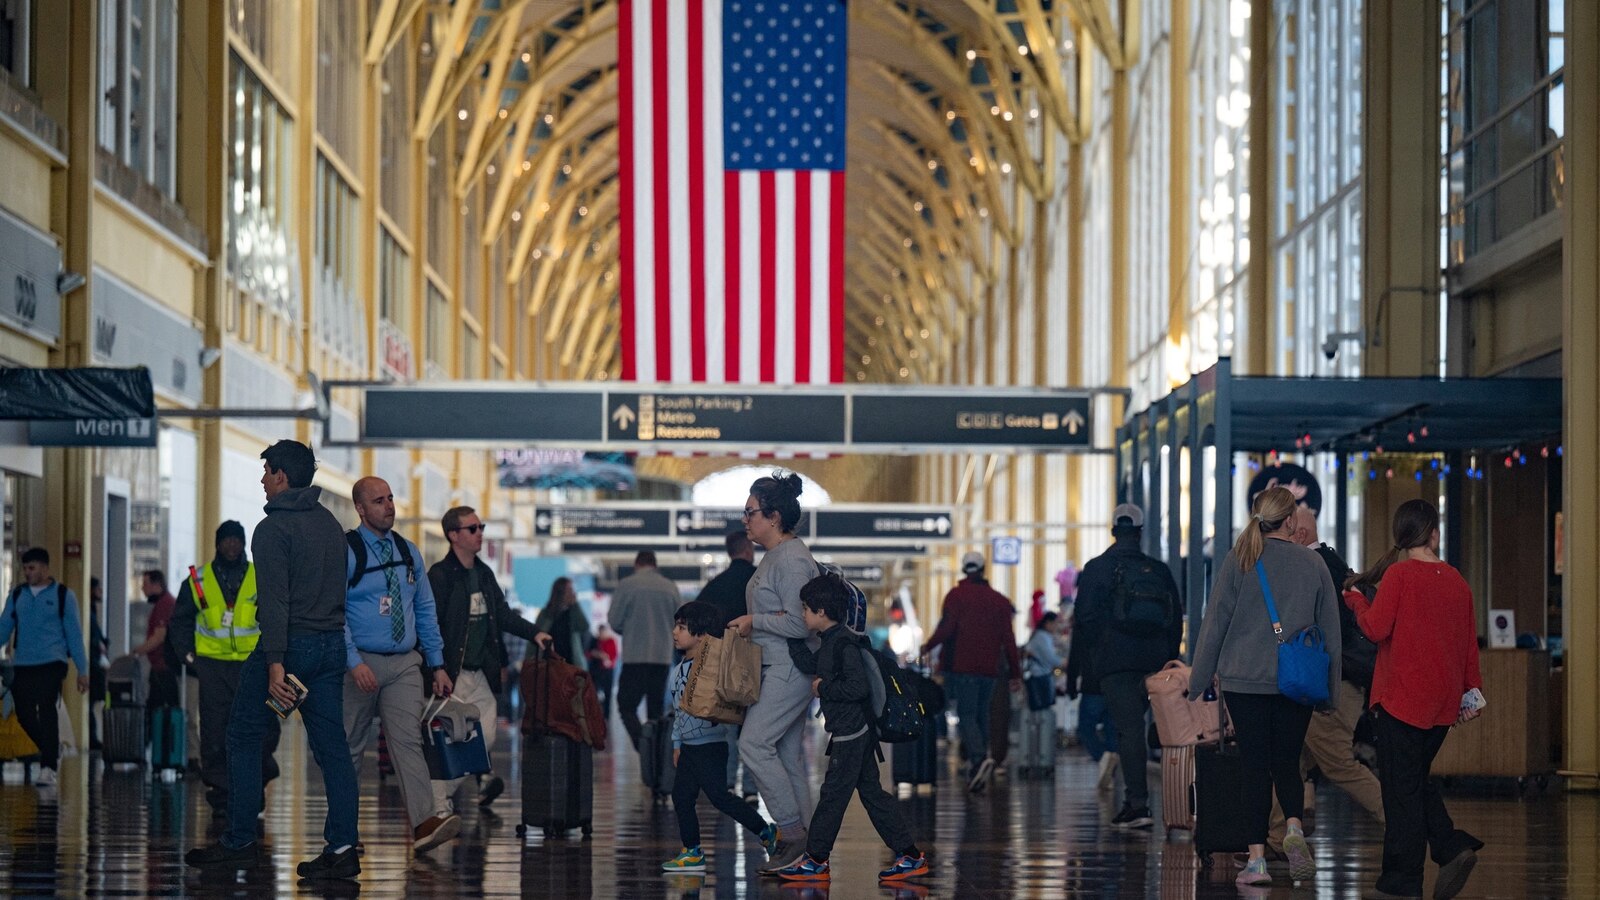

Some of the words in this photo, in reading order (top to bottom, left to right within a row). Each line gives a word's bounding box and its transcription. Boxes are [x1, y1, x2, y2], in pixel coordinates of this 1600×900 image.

[657, 396, 695, 409] South
[697, 396, 742, 413] Parking
[657, 411, 697, 424] Metro
[1005, 413, 1041, 428] Gates
[76, 419, 124, 436] Men
[657, 425, 721, 439] Restrooms
